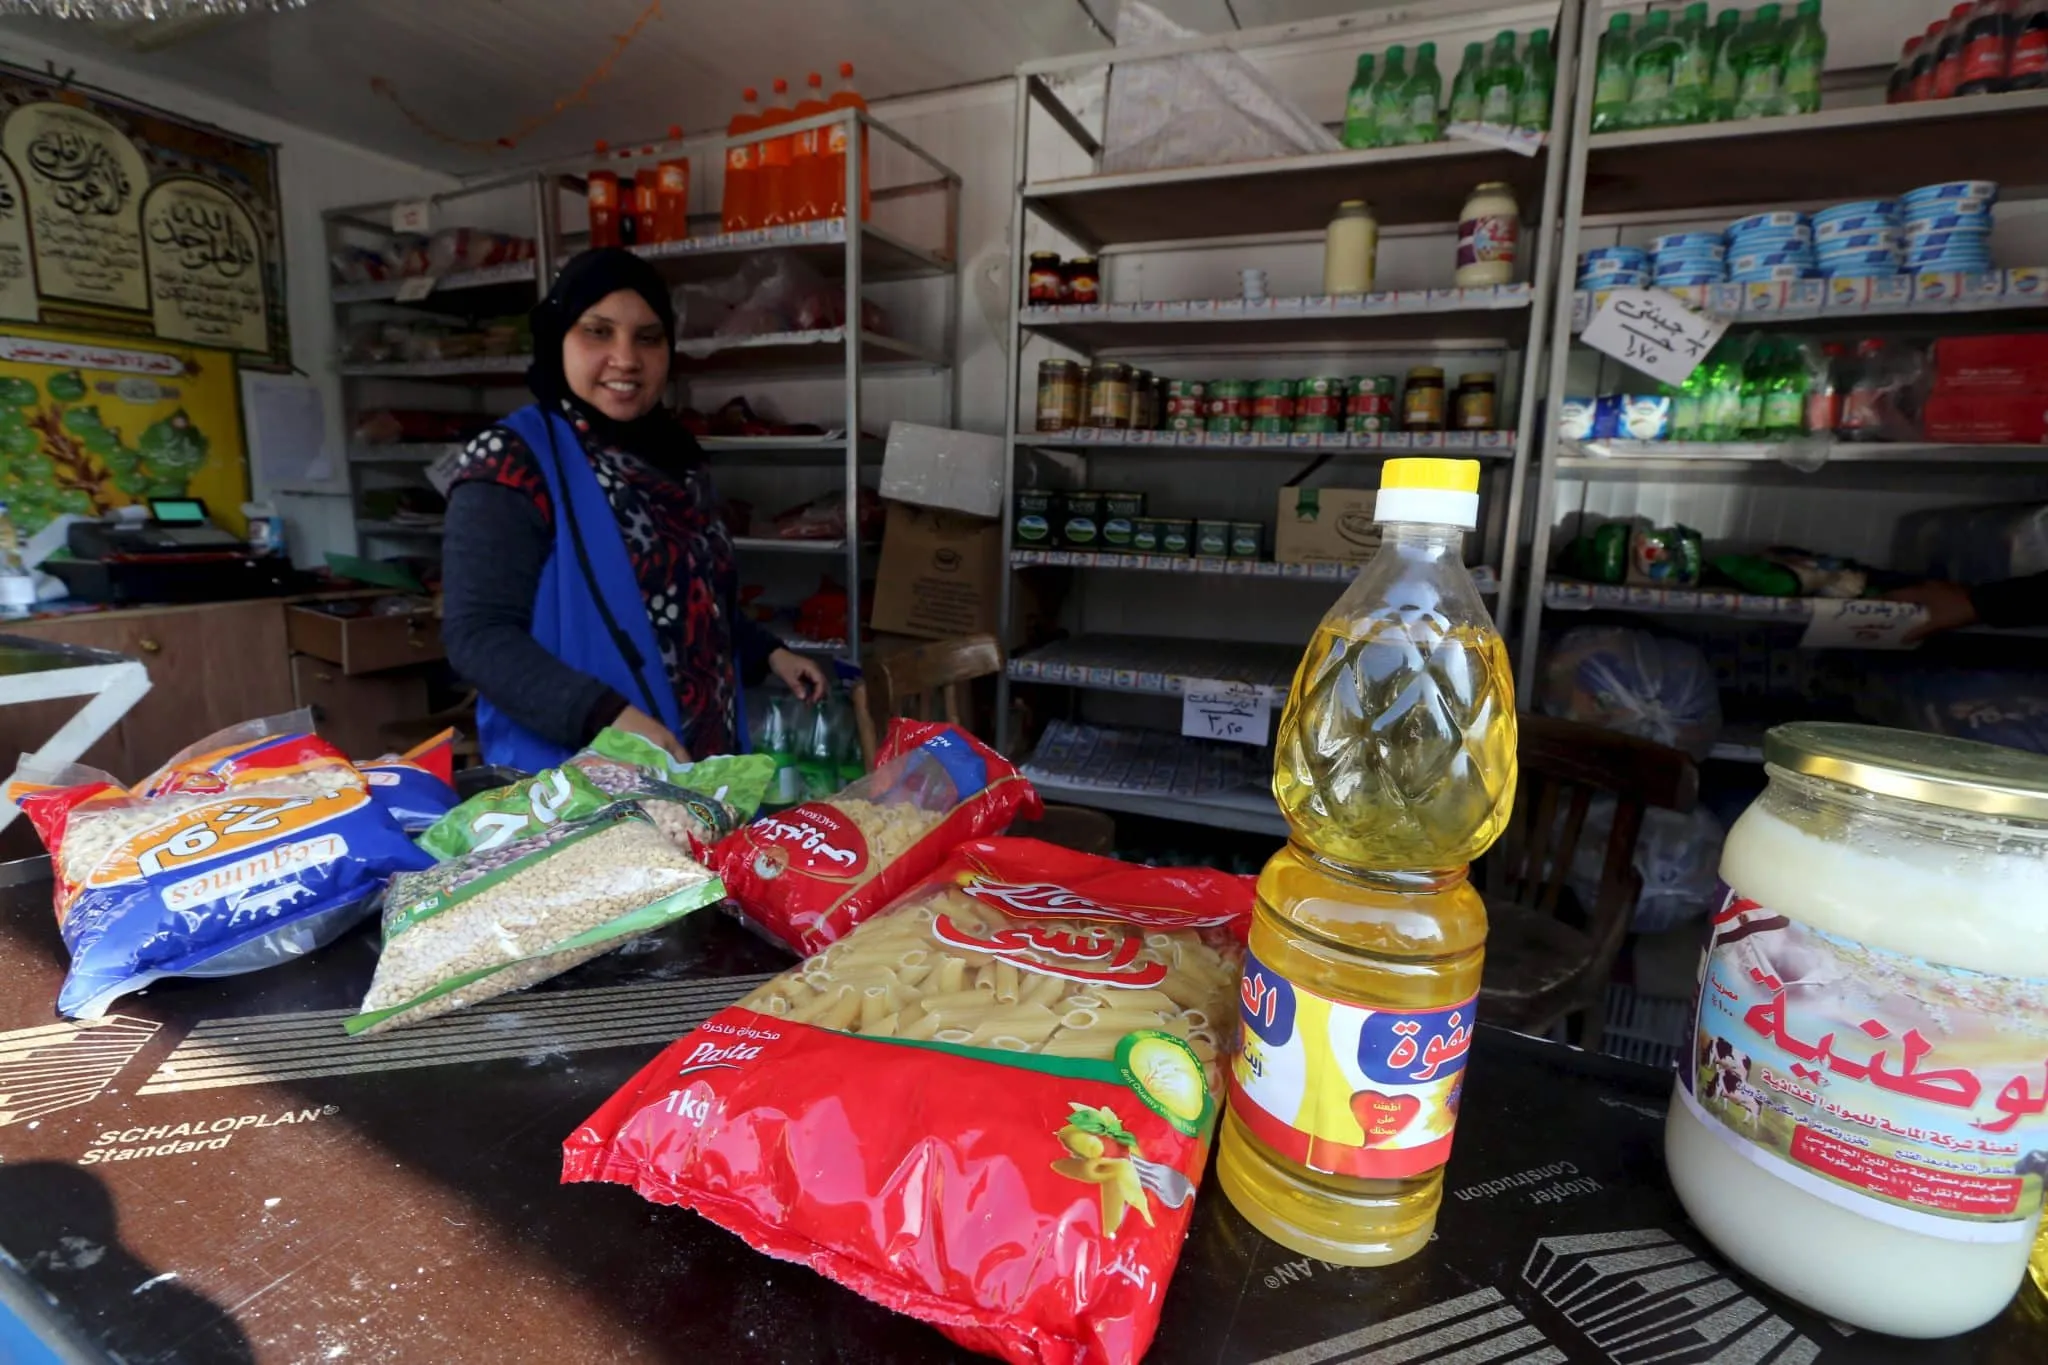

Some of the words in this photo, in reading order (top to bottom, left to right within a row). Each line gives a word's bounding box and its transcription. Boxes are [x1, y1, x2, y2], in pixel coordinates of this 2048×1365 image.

[683, 1041, 764, 1066] Pasta
[77, 1133, 236, 1166] Standard
[1454, 1160, 1580, 1201] Construction
[1528, 1175, 1603, 1205] Klopfer
